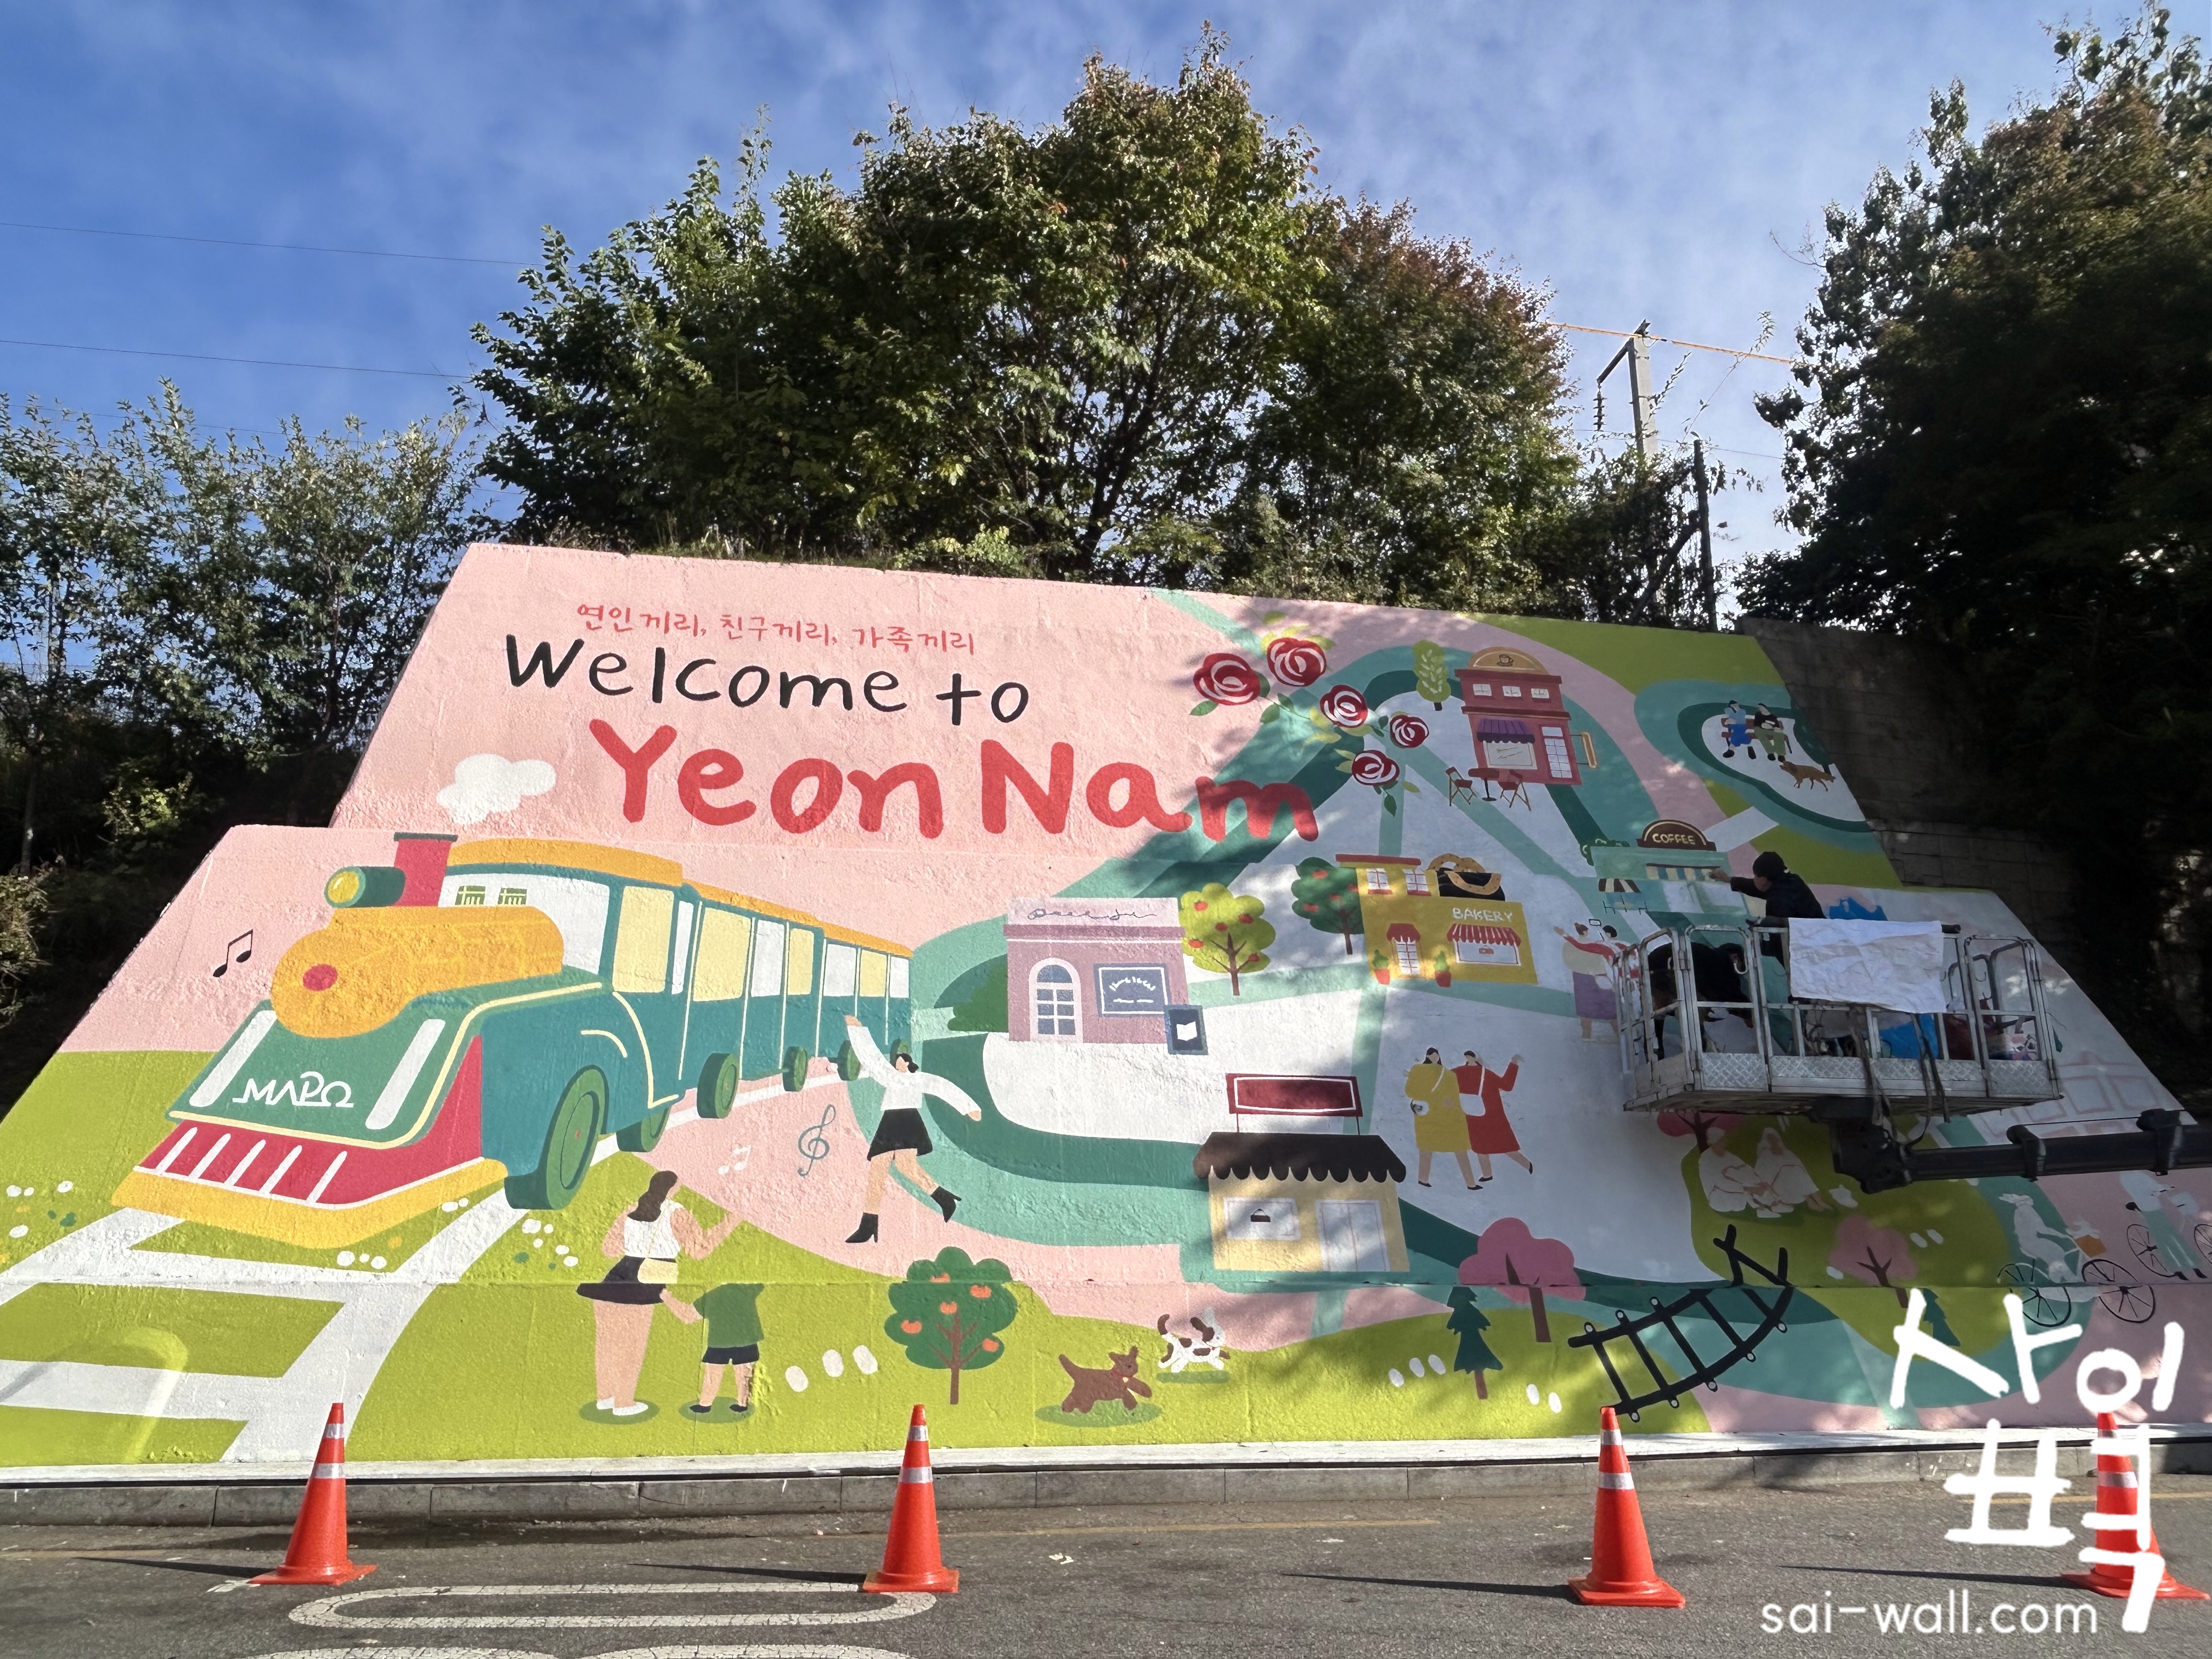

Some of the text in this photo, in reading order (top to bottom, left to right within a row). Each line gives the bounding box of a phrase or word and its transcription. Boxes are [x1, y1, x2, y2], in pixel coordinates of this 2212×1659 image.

[852, 625, 974, 655] 가족끼리
[506, 634, 1029, 726] Welcome to
[589, 719, 1319, 842] Yeon Nam
[1652, 833, 1696, 845] COFFEE
[1452, 907, 1513, 923] BAKERY
[232, 1071, 354, 1108] MAPO
